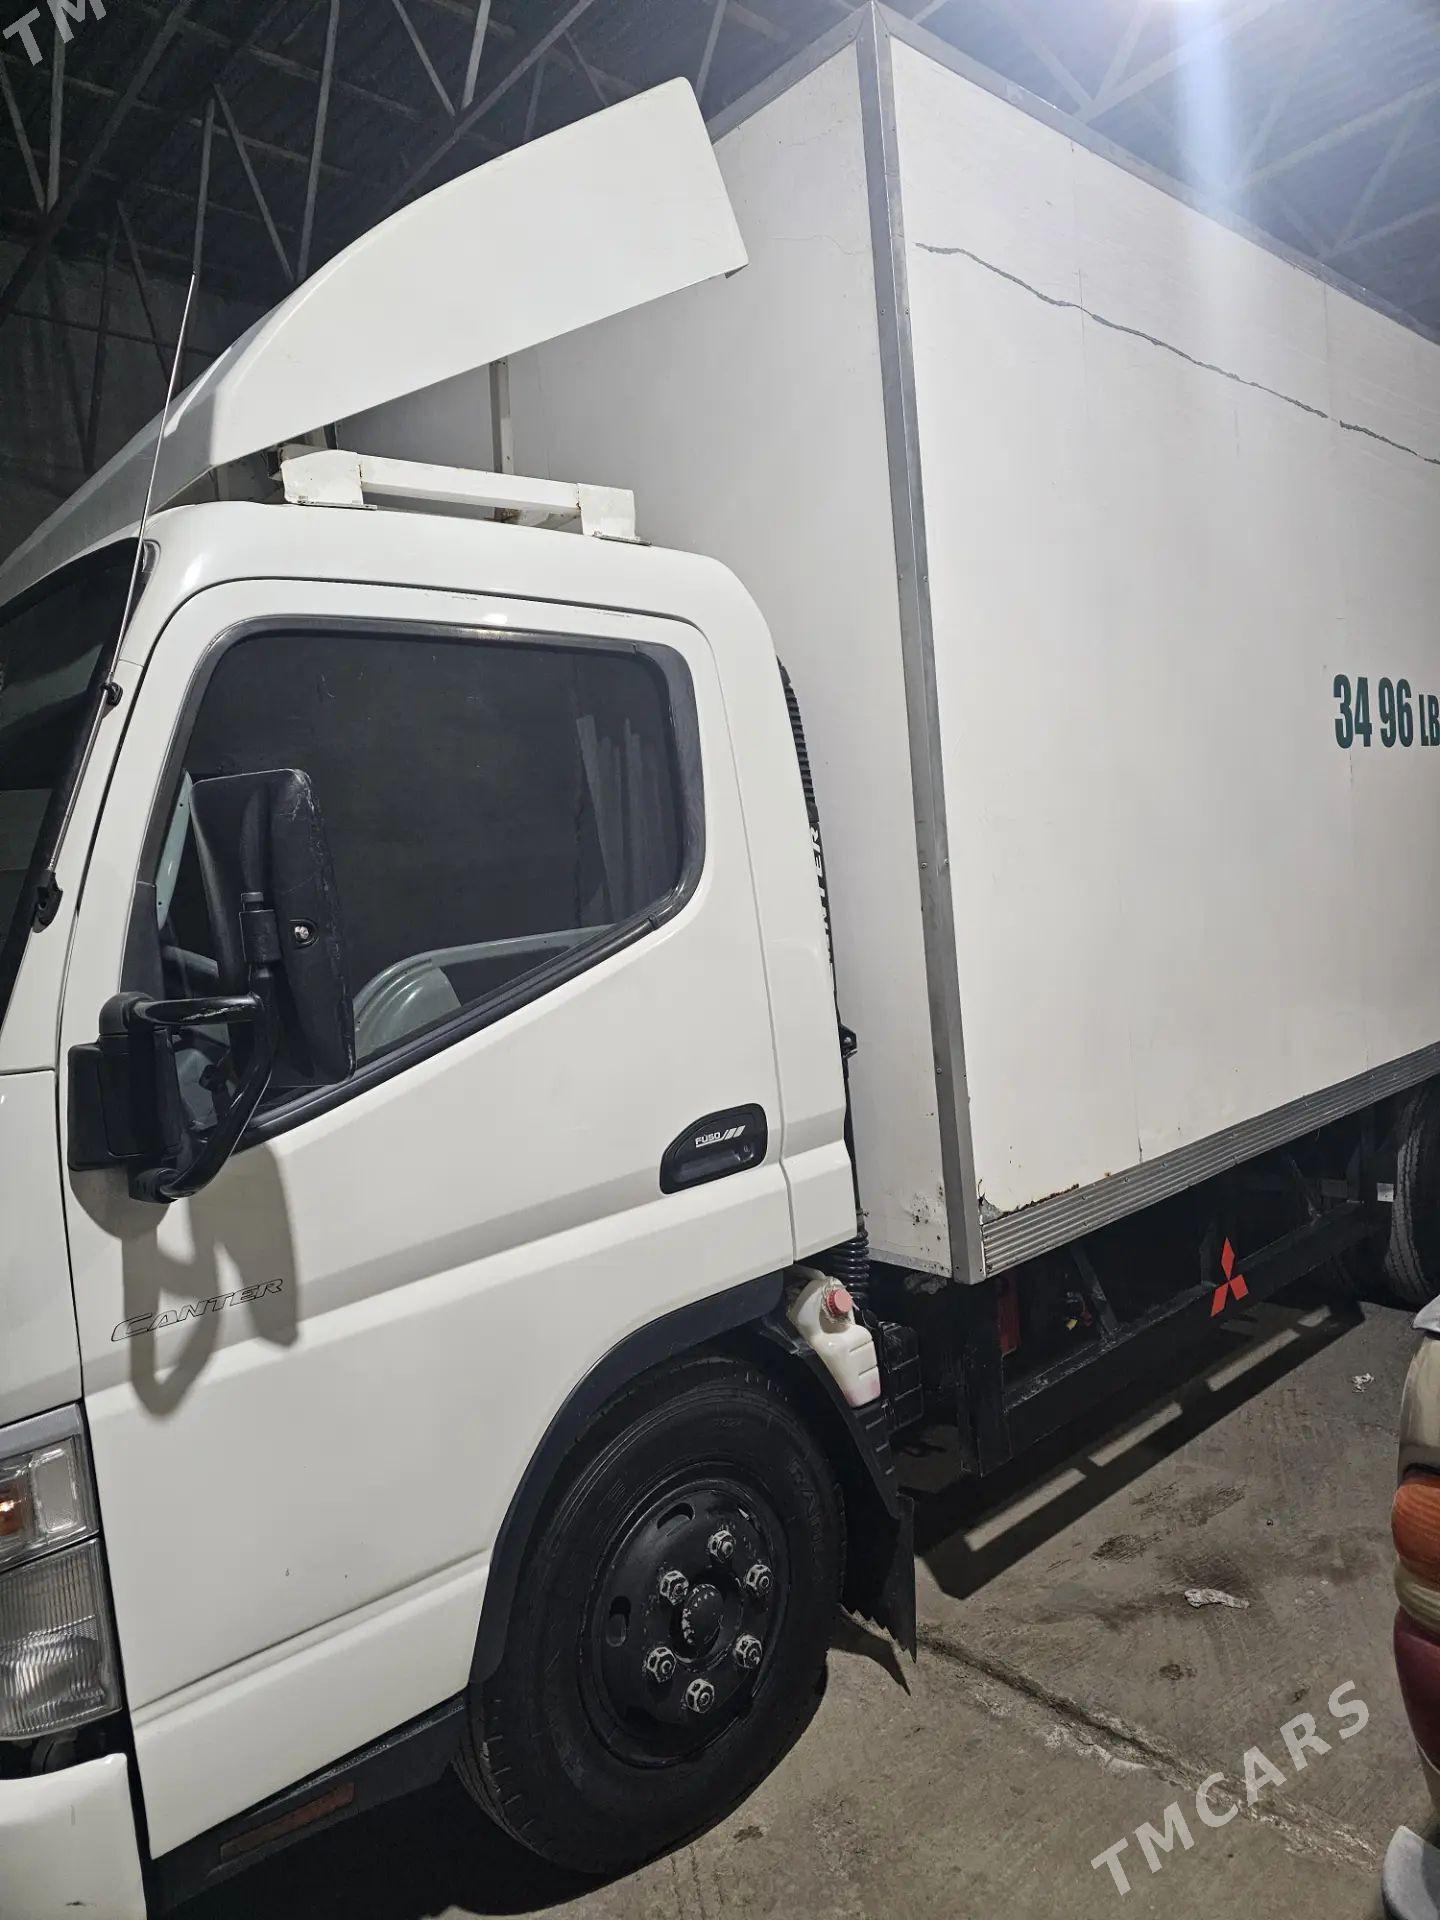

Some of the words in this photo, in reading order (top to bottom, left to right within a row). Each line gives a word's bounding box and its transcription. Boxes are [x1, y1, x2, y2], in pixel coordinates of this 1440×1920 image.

[1333, 673, 1373, 749] 34
[1378, 677, 1414, 748] 96
[1418, 694, 1440, 747] LB
[694, 1131, 721, 1147] FUSO
[111, 1278, 283, 1342] CANTER
